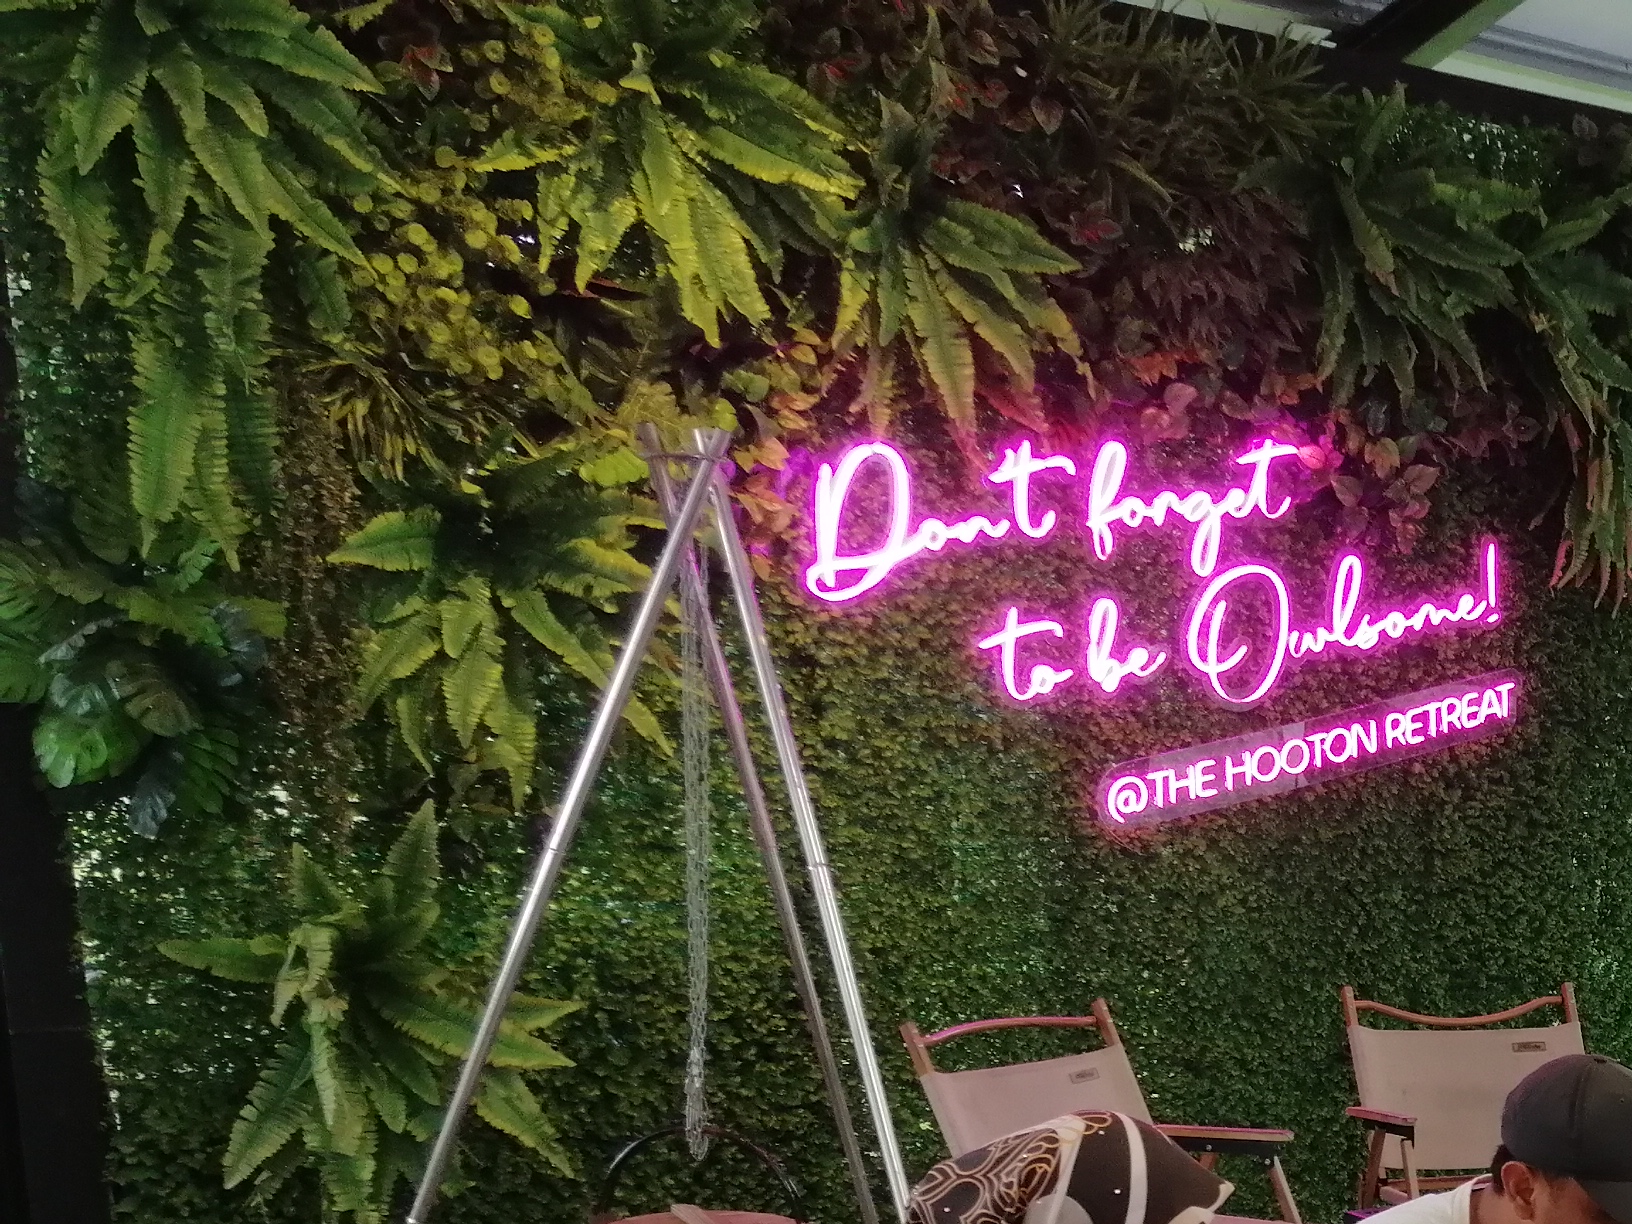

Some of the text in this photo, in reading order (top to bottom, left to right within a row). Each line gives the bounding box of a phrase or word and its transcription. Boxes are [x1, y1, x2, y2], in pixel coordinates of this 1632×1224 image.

[1085, 439, 1300, 577] forget
[978, 543, 1500, 703] to be Owlsome!
[1107, 682, 1516, 824] @THE HOOTON RETREAT
